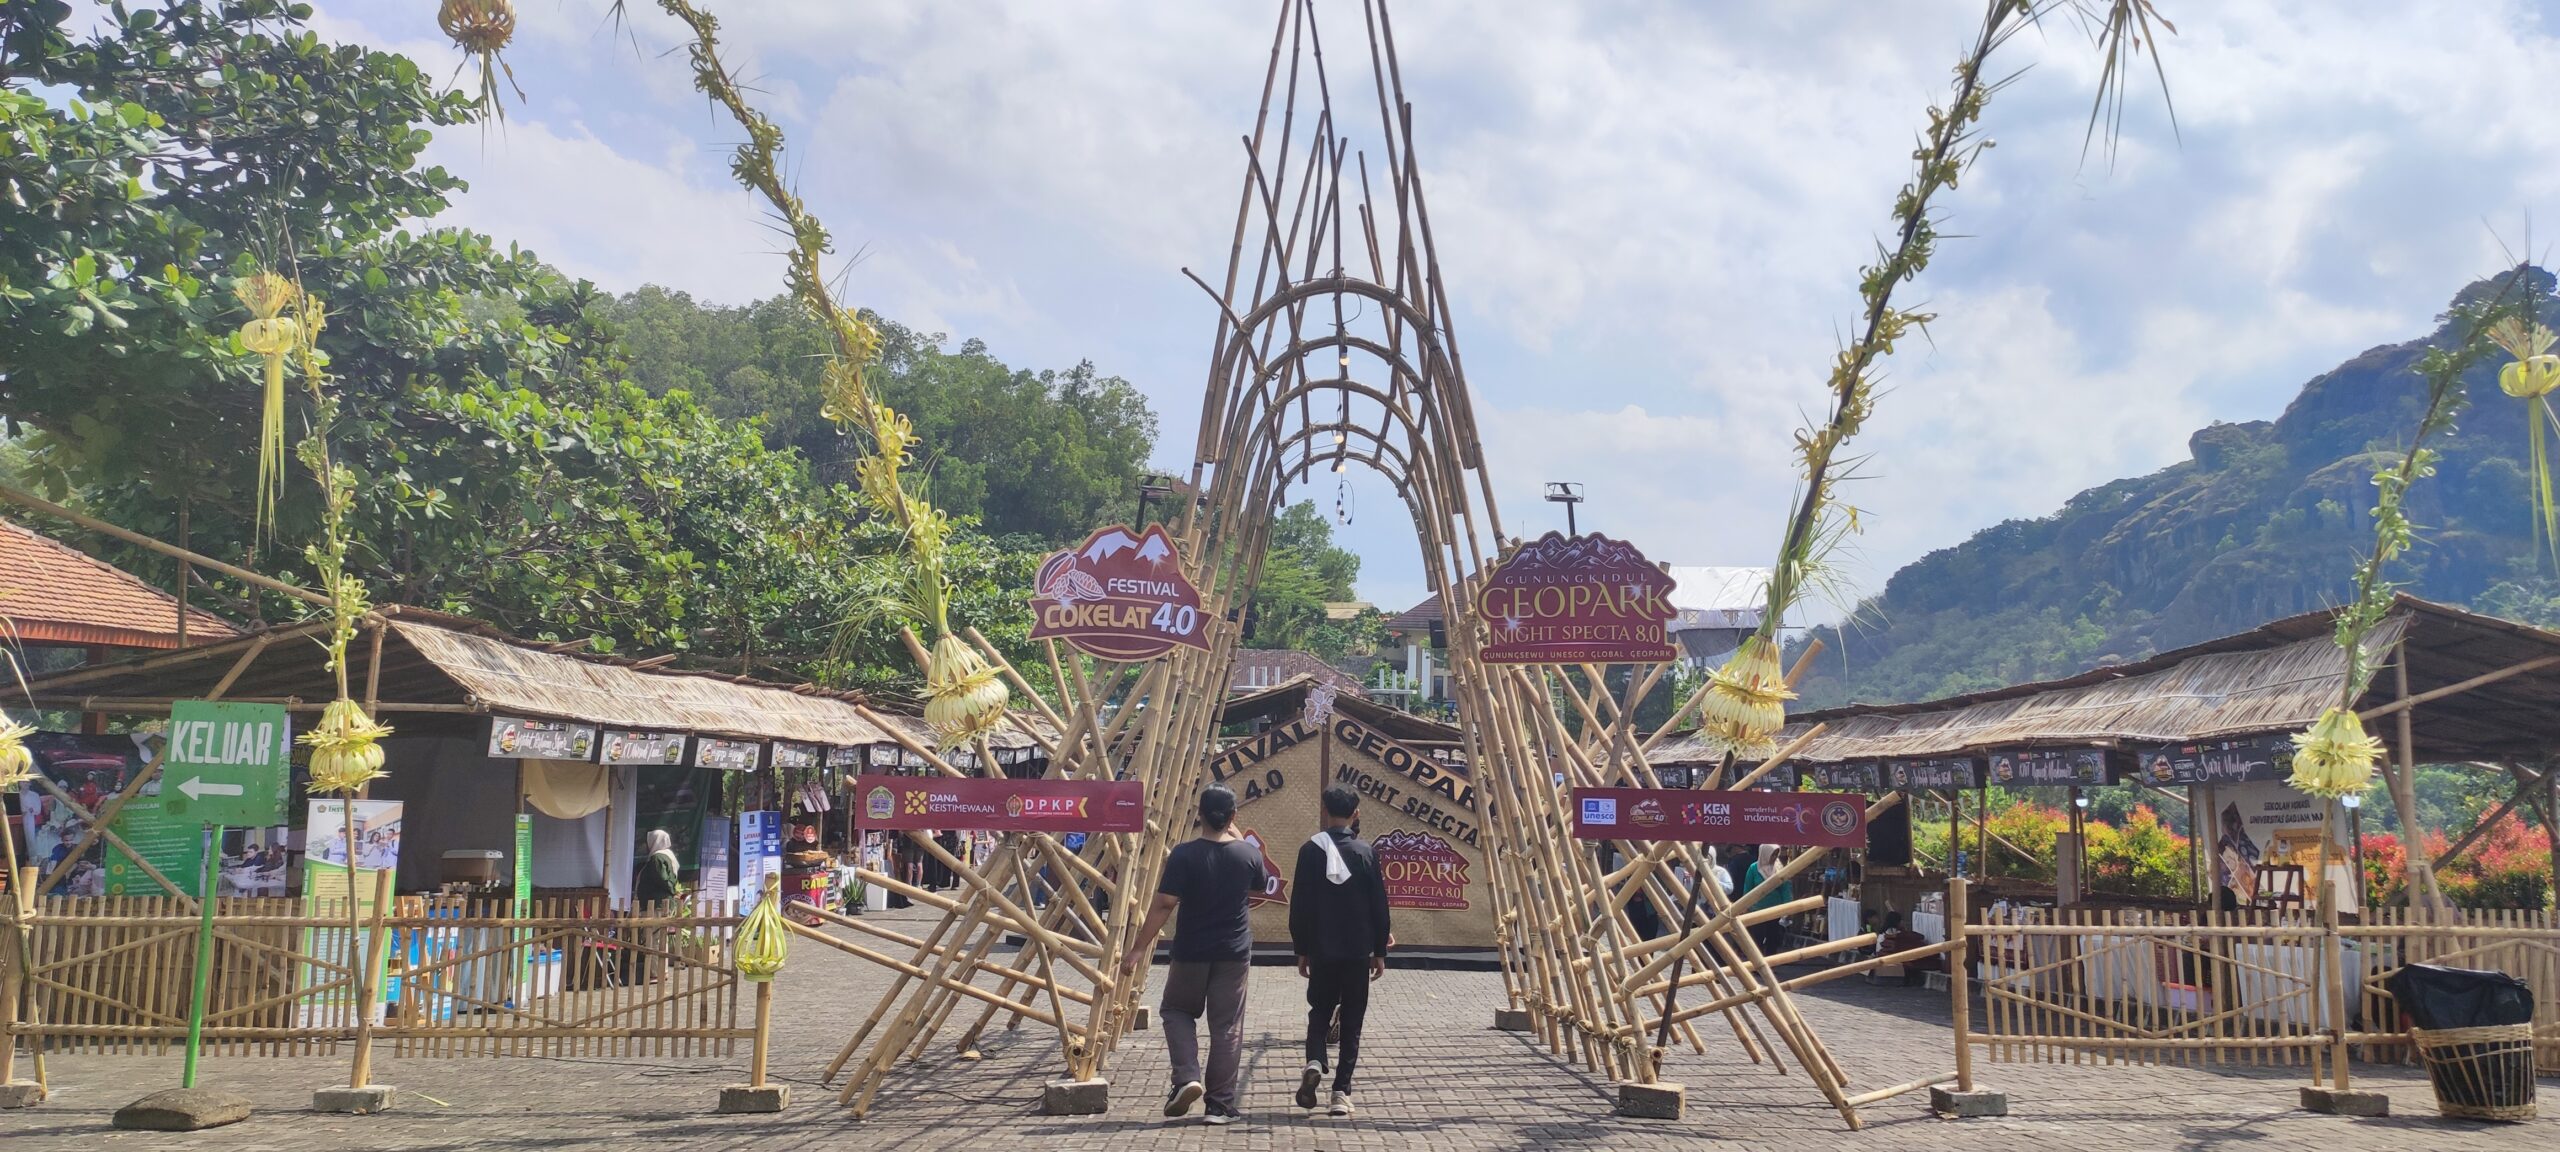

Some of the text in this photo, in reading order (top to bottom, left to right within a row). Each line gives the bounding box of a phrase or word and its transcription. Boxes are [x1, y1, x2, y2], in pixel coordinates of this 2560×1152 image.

[1505, 573, 1647, 585] GUNUNGKIDUL
[1107, 577, 1180, 597] FESTIVAL
[1481, 581, 1672, 621] GEOPARK
[1044, 602, 1196, 636] COKELAT 4.0
[1494, 624, 1660, 646] NIGHT SPECTA 8.0
[1483, 650, 1671, 660] GUNUNGSEWU UNESCO GLOBAL GEOPARK
[170, 720, 273, 766] KELUAR
[1211, 722, 1318, 783] TIVAL
[1245, 769, 1284, 800] 4.0
[929, 793, 958, 803] DANA
[929, 803, 995, 813] KEISTIMEWAAN
[1336, 763, 1479, 848] NIGHT SPECTA
[1703, 803, 1730, 815] KEN
[1703, 815, 1731, 826] 2026
[1744, 813, 1790, 823] indonesia
[2249, 814, 2285, 824] UNIVERSITAS
[1380, 854, 1454, 862] NUNGKIDUL
[1382, 859, 1469, 886] OPARK
[1402, 885, 1444, 897] SPECTA
[1445, 887, 1460, 899] 8.0
